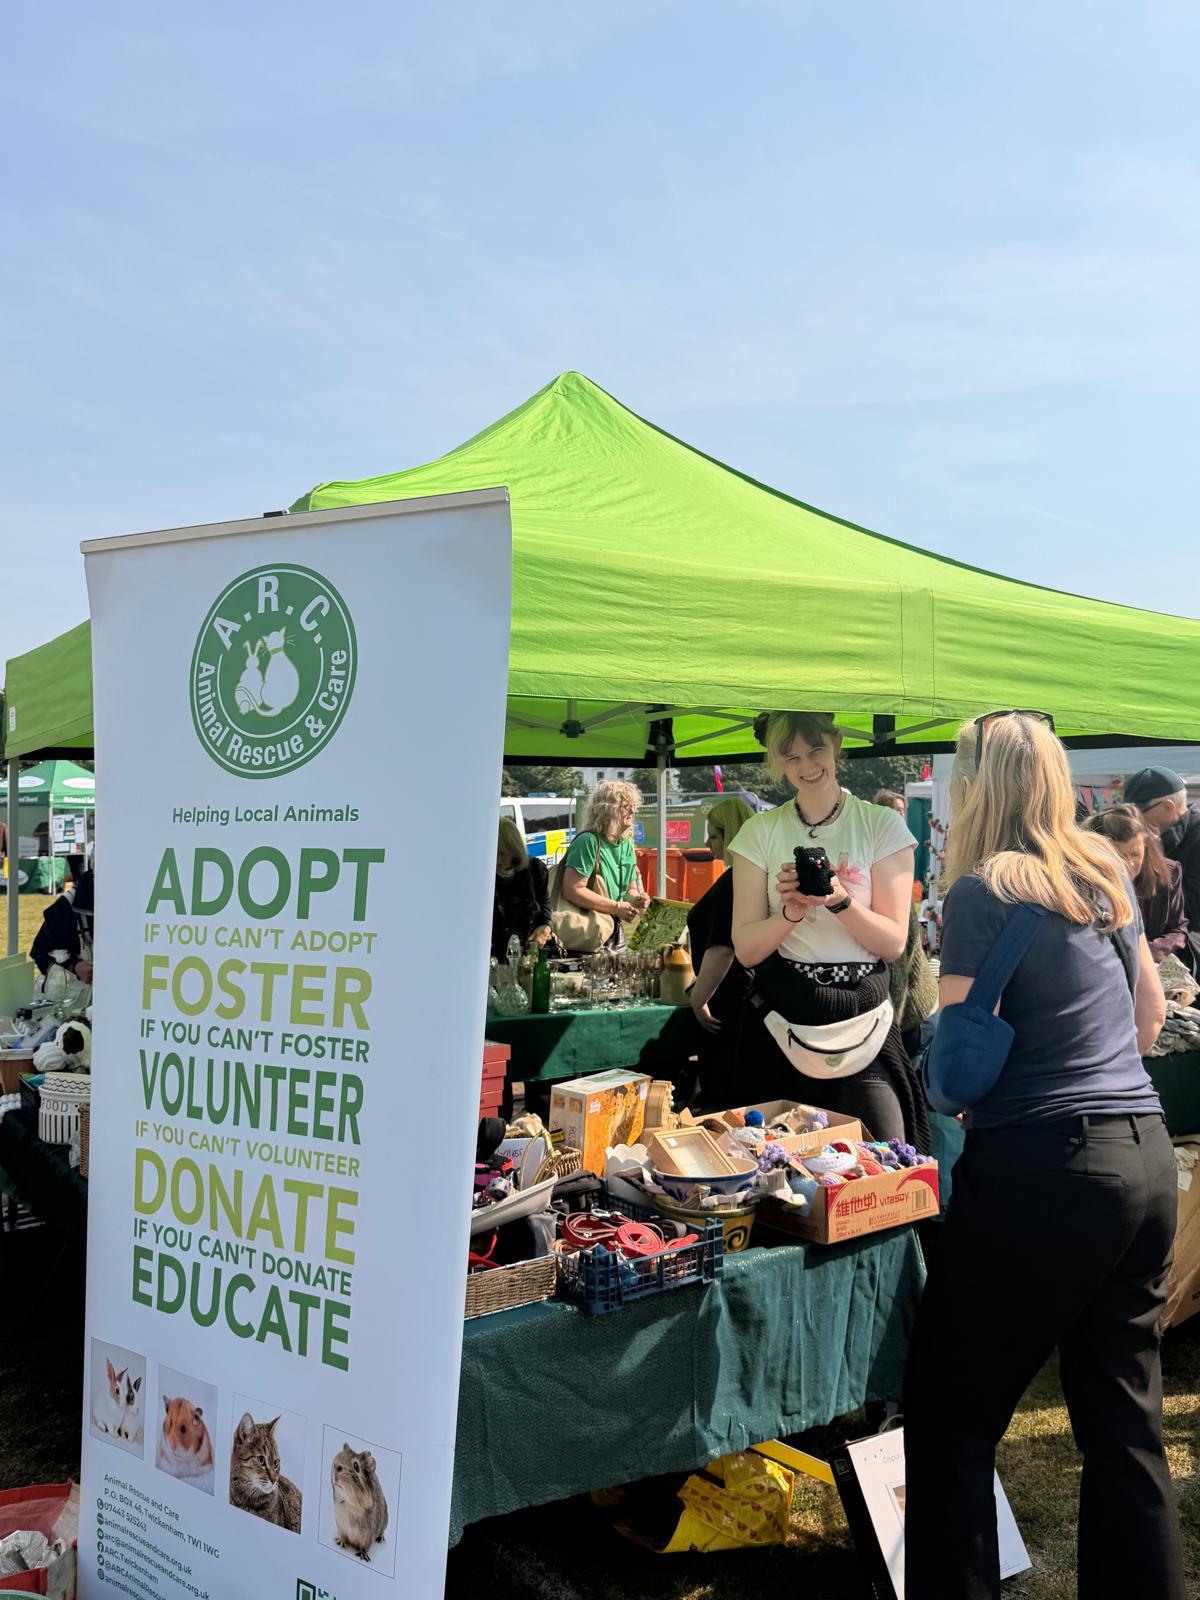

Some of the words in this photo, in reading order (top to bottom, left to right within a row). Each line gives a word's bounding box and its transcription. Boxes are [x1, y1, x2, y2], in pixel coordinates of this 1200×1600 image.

[212, 575, 330, 651] A.R.C.
[198, 661, 230, 748] Animal
[226, 733, 305, 766] Rescue
[304, 714, 327, 738] &
[318, 649, 347, 712] Care
[172, 805, 230, 827] Helping
[234, 804, 279, 822] Local
[283, 803, 360, 823] Animals
[145, 845, 386, 922] ADOPT
[144, 923, 160, 943] IF
[165, 923, 208, 946] YOU
[214, 926, 285, 950] CAN'T
[290, 929, 378, 954] ADOPT
[142, 954, 373, 1031] FOSTER
[140, 1018, 156, 1039] IF
[160, 1020, 201, 1046] YOU
[207, 1026, 274, 1053] CAN'T
[280, 1032, 370, 1064] FOSTER
[139, 1049, 364, 1146] VOLUNTEER
[135, 1119, 149, 1138] IF
[152, 1122, 185, 1147] YOU
[188, 1131, 241, 1157] CAN'T
[245, 1140, 361, 1178] VOLUNTEER
[133, 1147, 359, 1267] DONATE
[835, 1191, 877, 1219] 維他奶
[133, 1217, 148, 1240] IF
[152, 1222, 193, 1253] YOU
[198, 1235, 257, 1270] CAN'T
[262, 1251, 353, 1297] DONATE
[132, 1244, 352, 1373] EDUCATE
[104, 1473, 128, 1491] Animal
[128, 1484, 151, 1504] Rescue
[151, 1499, 163, 1512] and
[163, 1505, 180, 1521] Care
[119, 1494, 133, 1509] BOX
[104, 1517, 193, 1577] animalrescueandcare.org.uk
